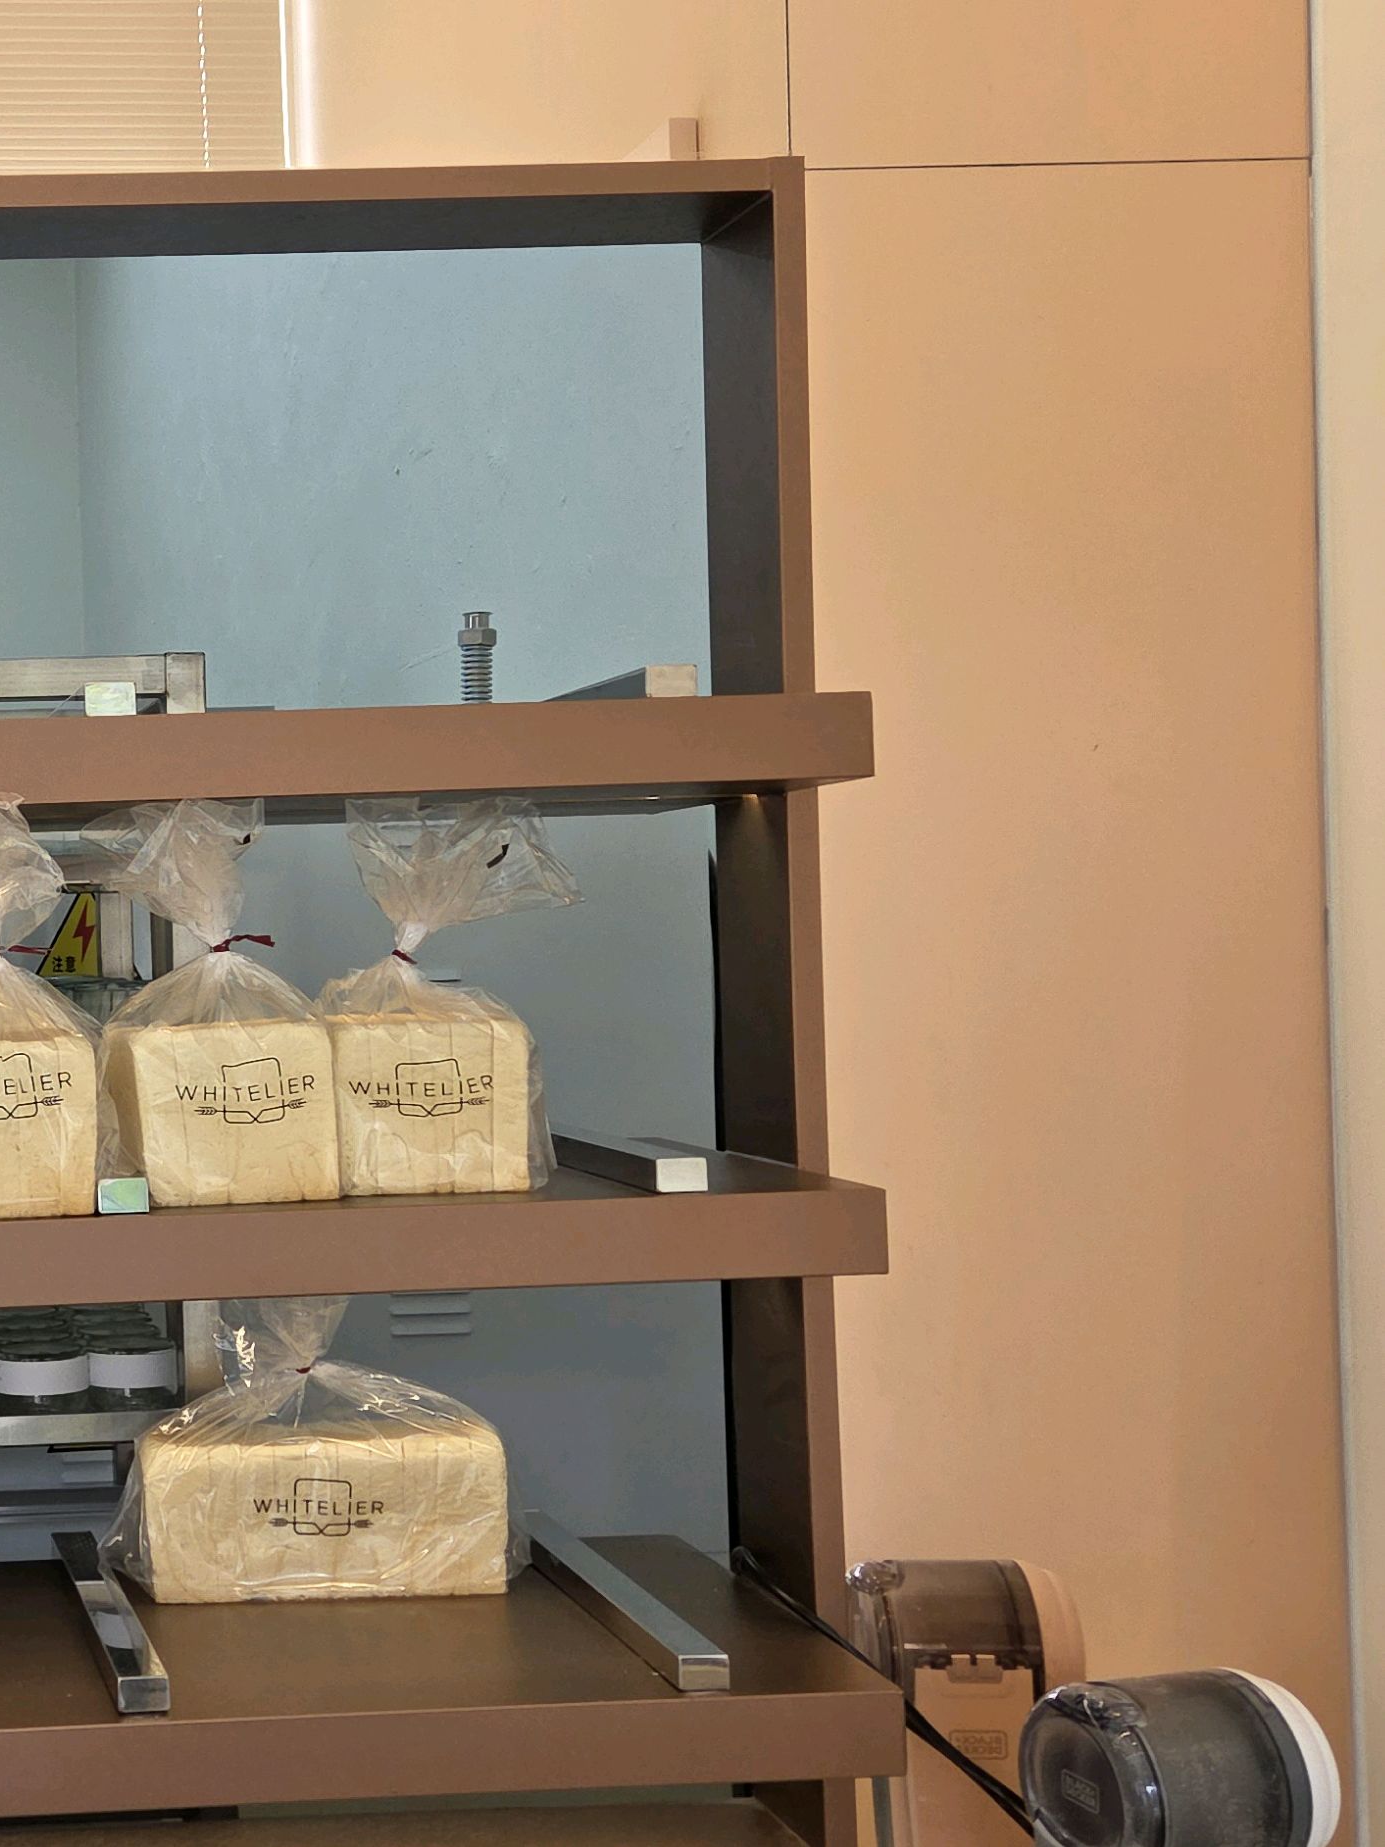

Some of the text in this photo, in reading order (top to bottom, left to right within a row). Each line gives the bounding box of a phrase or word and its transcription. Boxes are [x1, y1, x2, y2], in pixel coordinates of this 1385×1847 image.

[52, 955, 77, 973] 注意
[175, 1074, 315, 1102] WHITELIER
[349, 1074, 494, 1097] WHITELIER
[253, 1498, 384, 1516] WHITELIER
